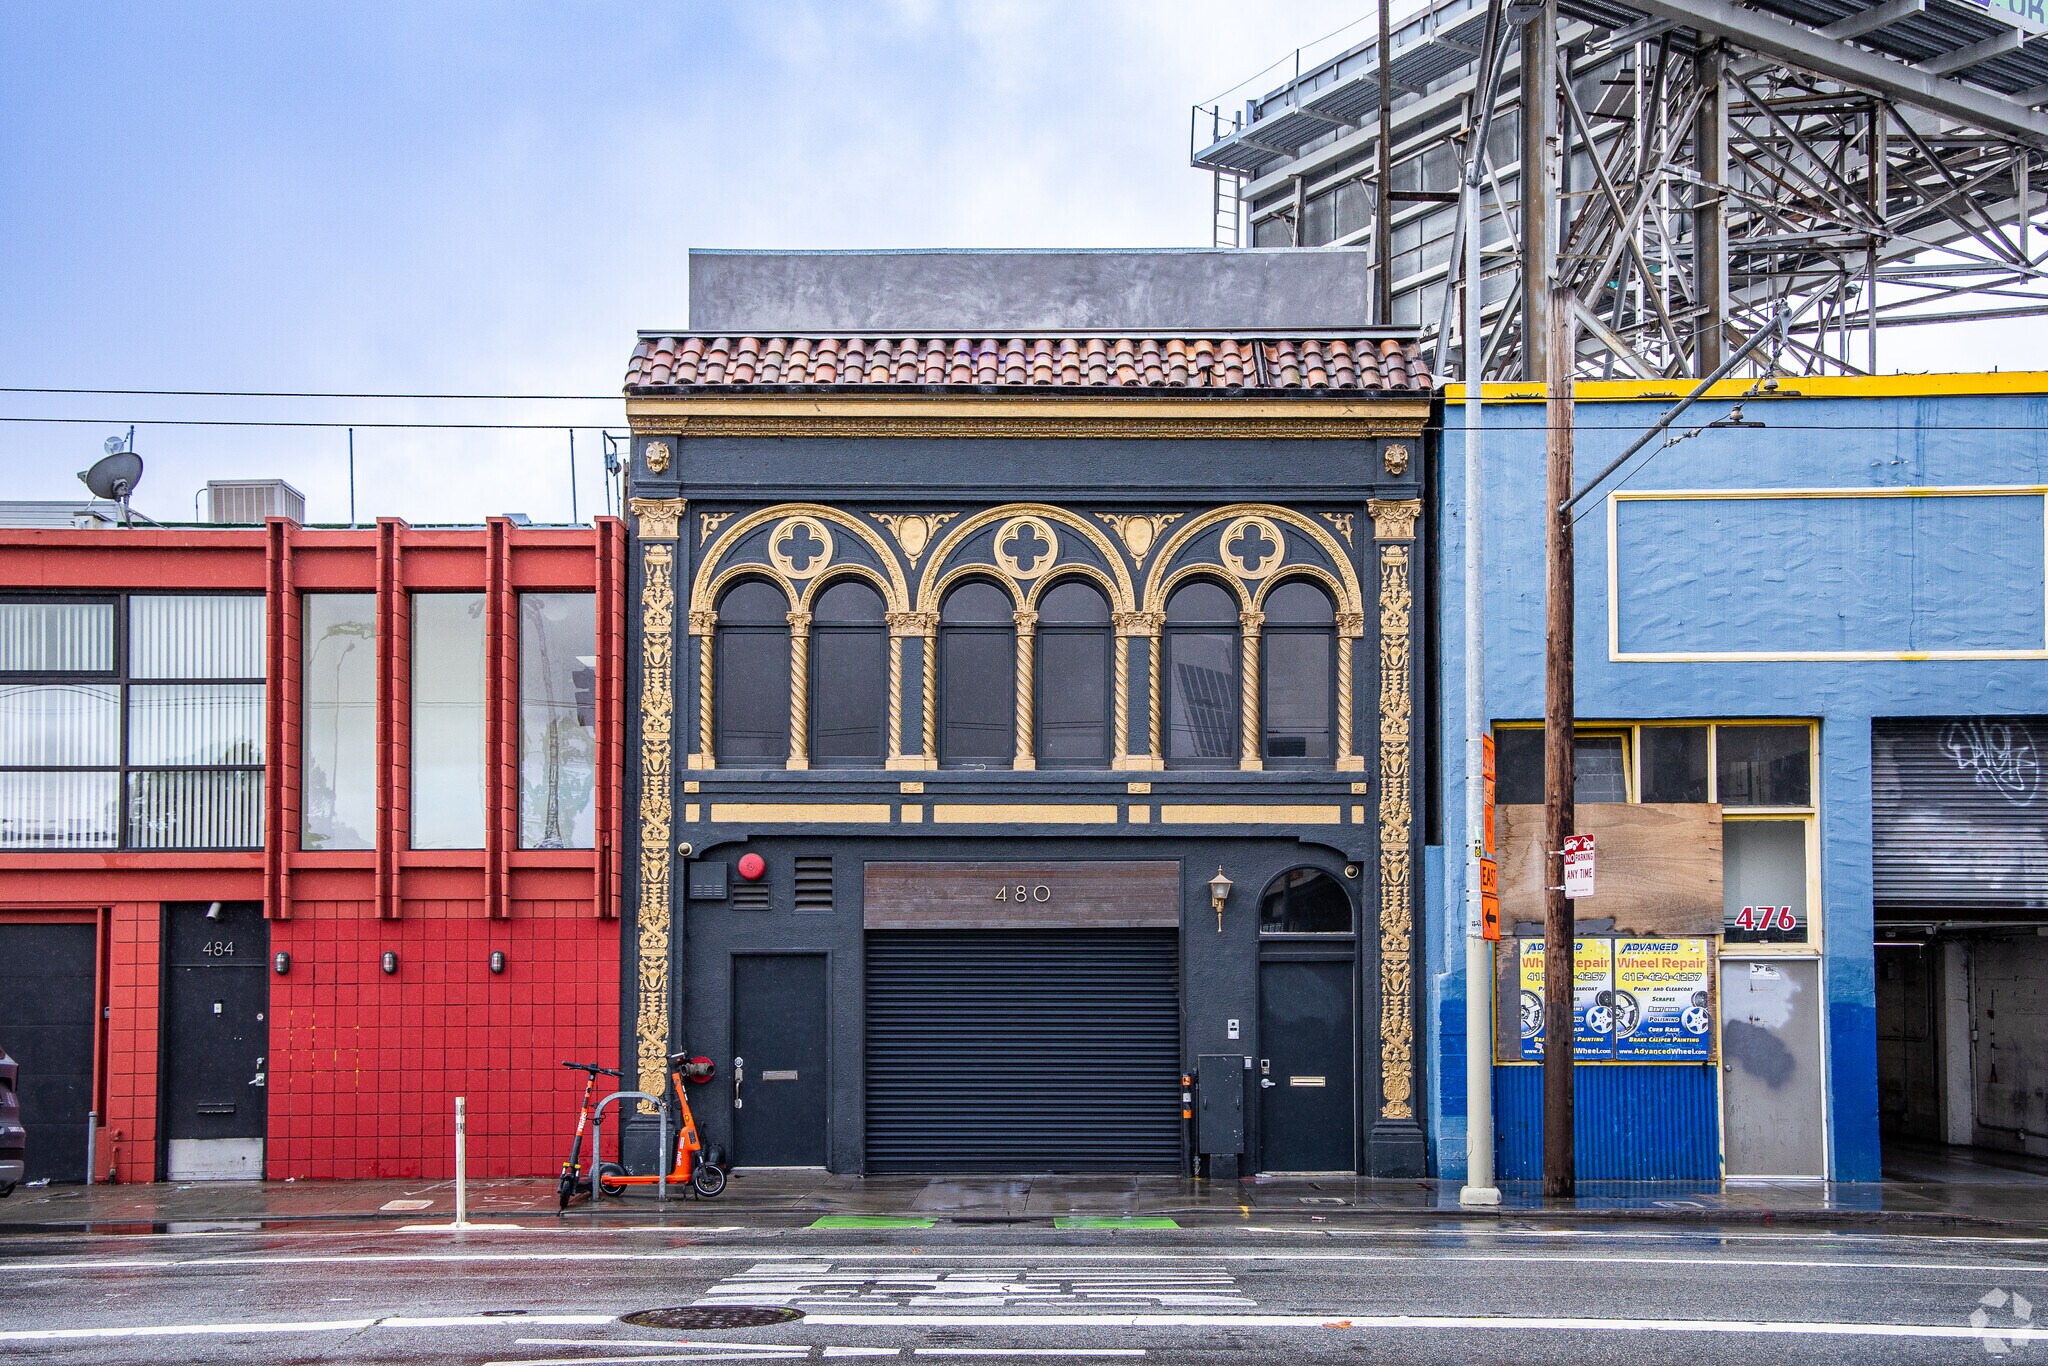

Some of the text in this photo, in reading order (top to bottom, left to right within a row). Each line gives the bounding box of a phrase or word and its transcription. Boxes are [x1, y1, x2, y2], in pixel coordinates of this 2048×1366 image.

[1565, 852, 1593, 863] NO PARKING
[1567, 868, 1592, 879] ANY TIME
[995, 885, 1050, 902] 480
[1735, 906, 1796, 931] 476
[203, 941, 235, 956] 484
[1619, 943, 1679, 954] ADVANCED
[1574, 957, 1609, 970] epair
[1617, 958, 1705, 970] Wheel Repair
[1622, 972, 1702, 981] 415-424-4257
